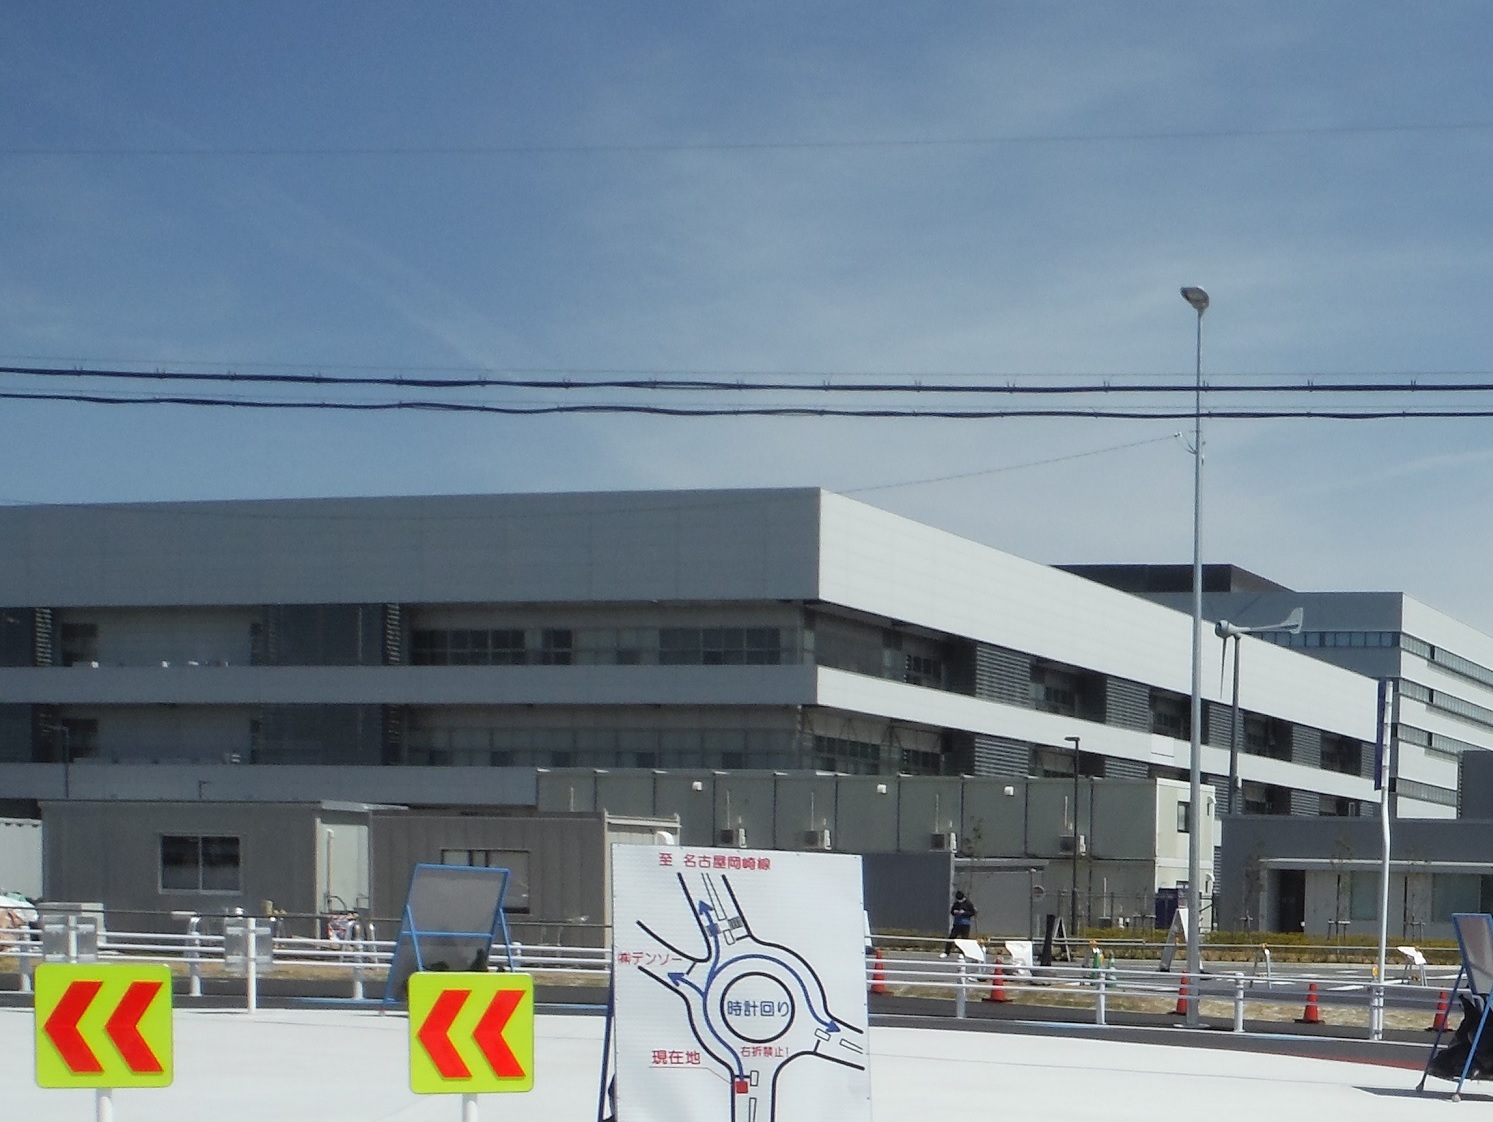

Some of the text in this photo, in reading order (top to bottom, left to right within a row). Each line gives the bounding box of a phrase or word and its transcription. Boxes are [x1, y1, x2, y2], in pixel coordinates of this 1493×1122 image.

[659, 852, 771, 870] 至 名古屋岡崎線
[727, 1000, 790, 1017] 時計回り
[651, 1049, 701, 1065] 現在地
